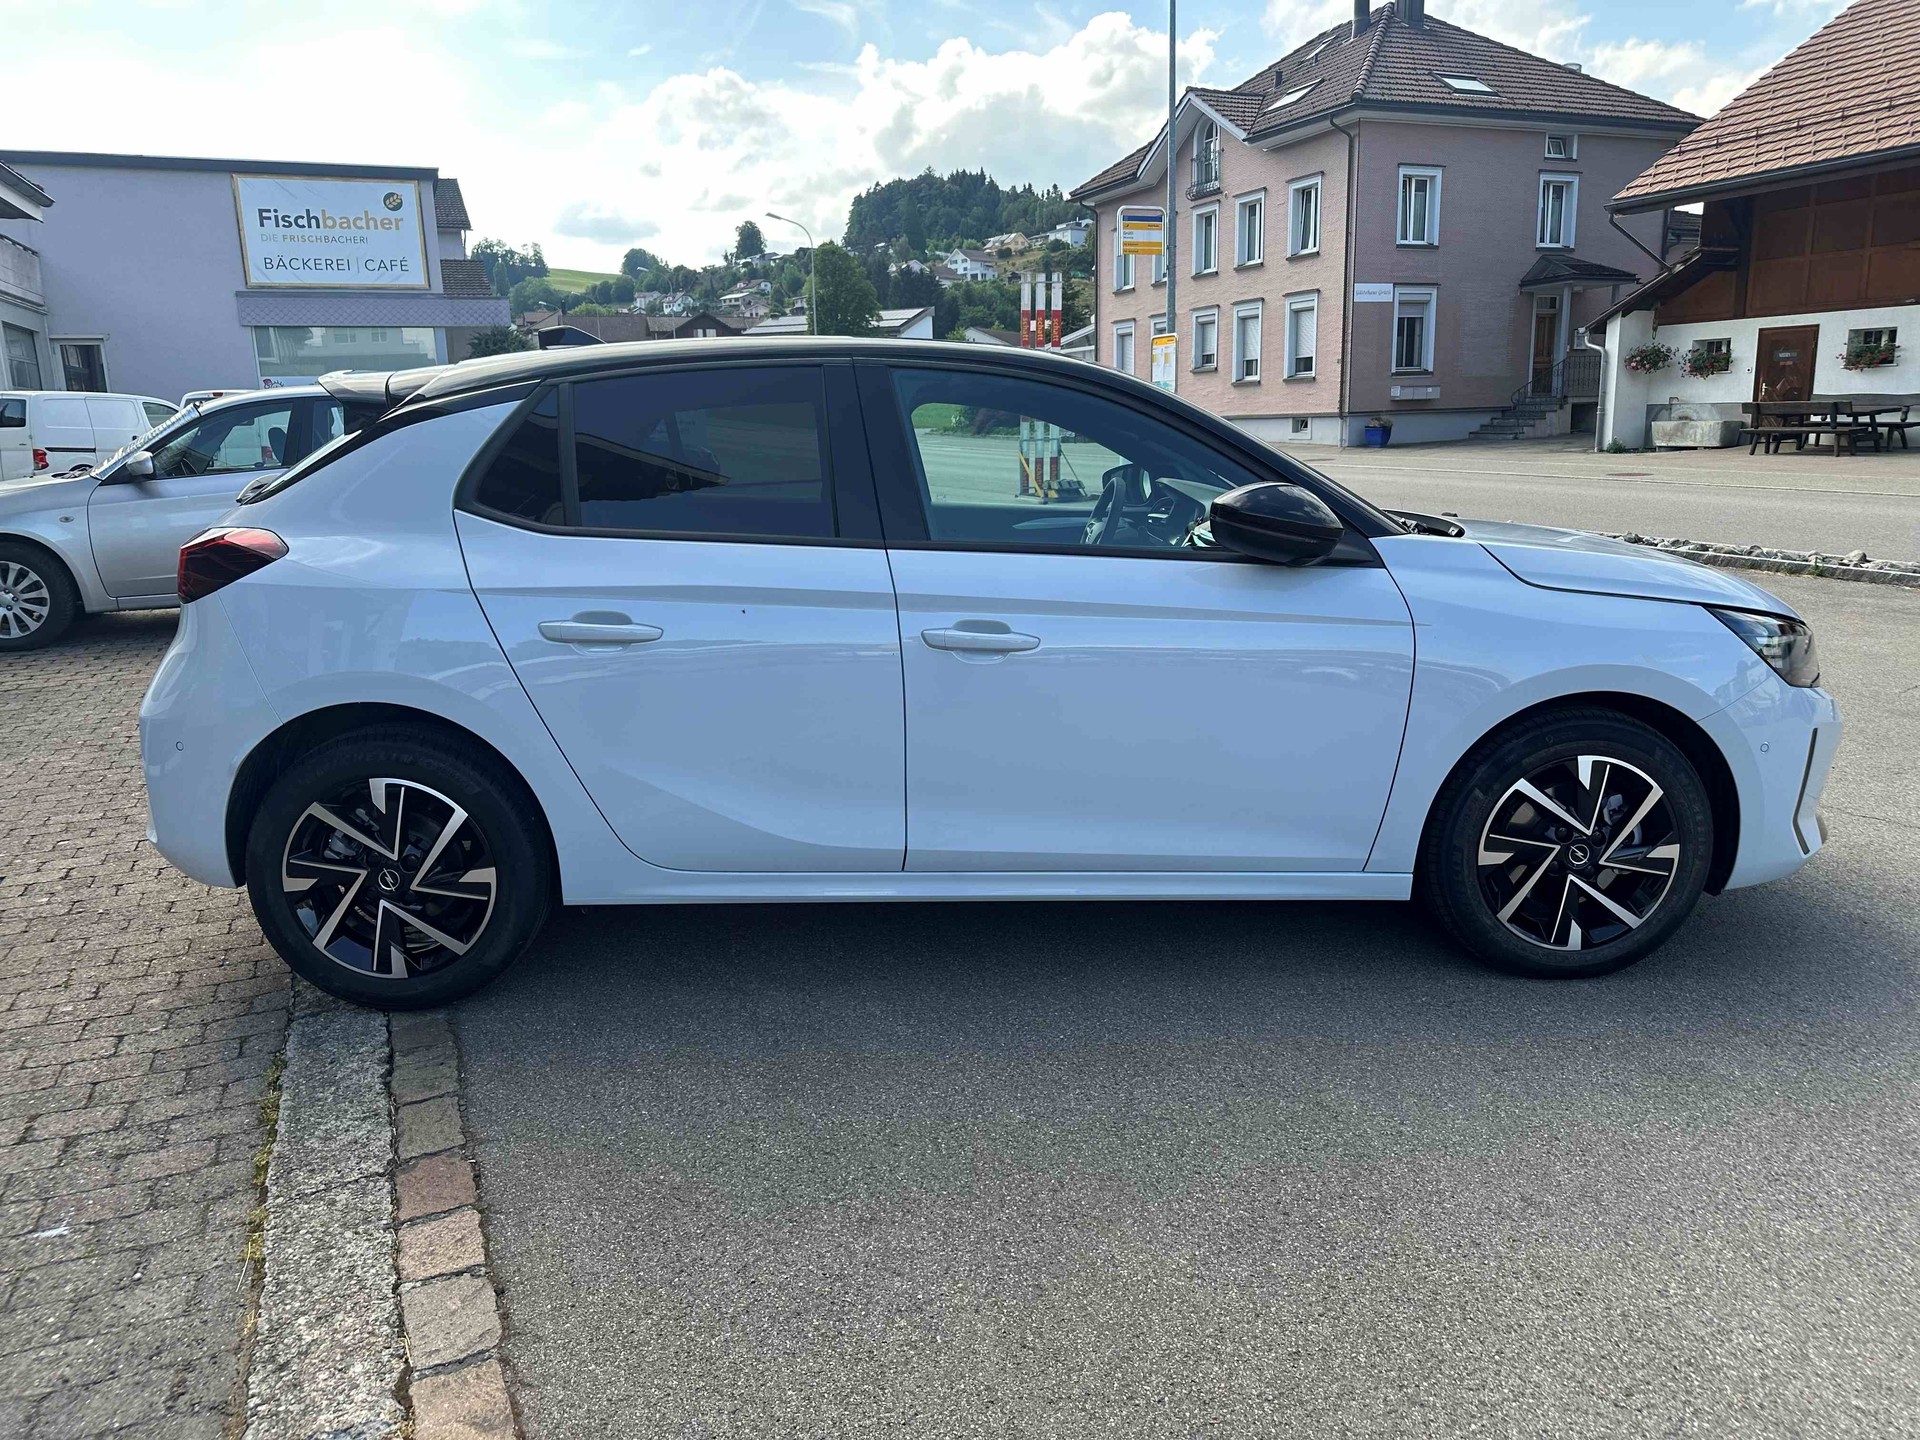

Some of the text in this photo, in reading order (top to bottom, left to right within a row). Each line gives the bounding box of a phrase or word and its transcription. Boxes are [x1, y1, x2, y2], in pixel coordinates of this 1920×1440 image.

[257, 208, 404, 231] Fischbacher
[260, 233, 278, 243] DIE
[263, 255, 410, 272] BÄCKEREI CAFÉ
